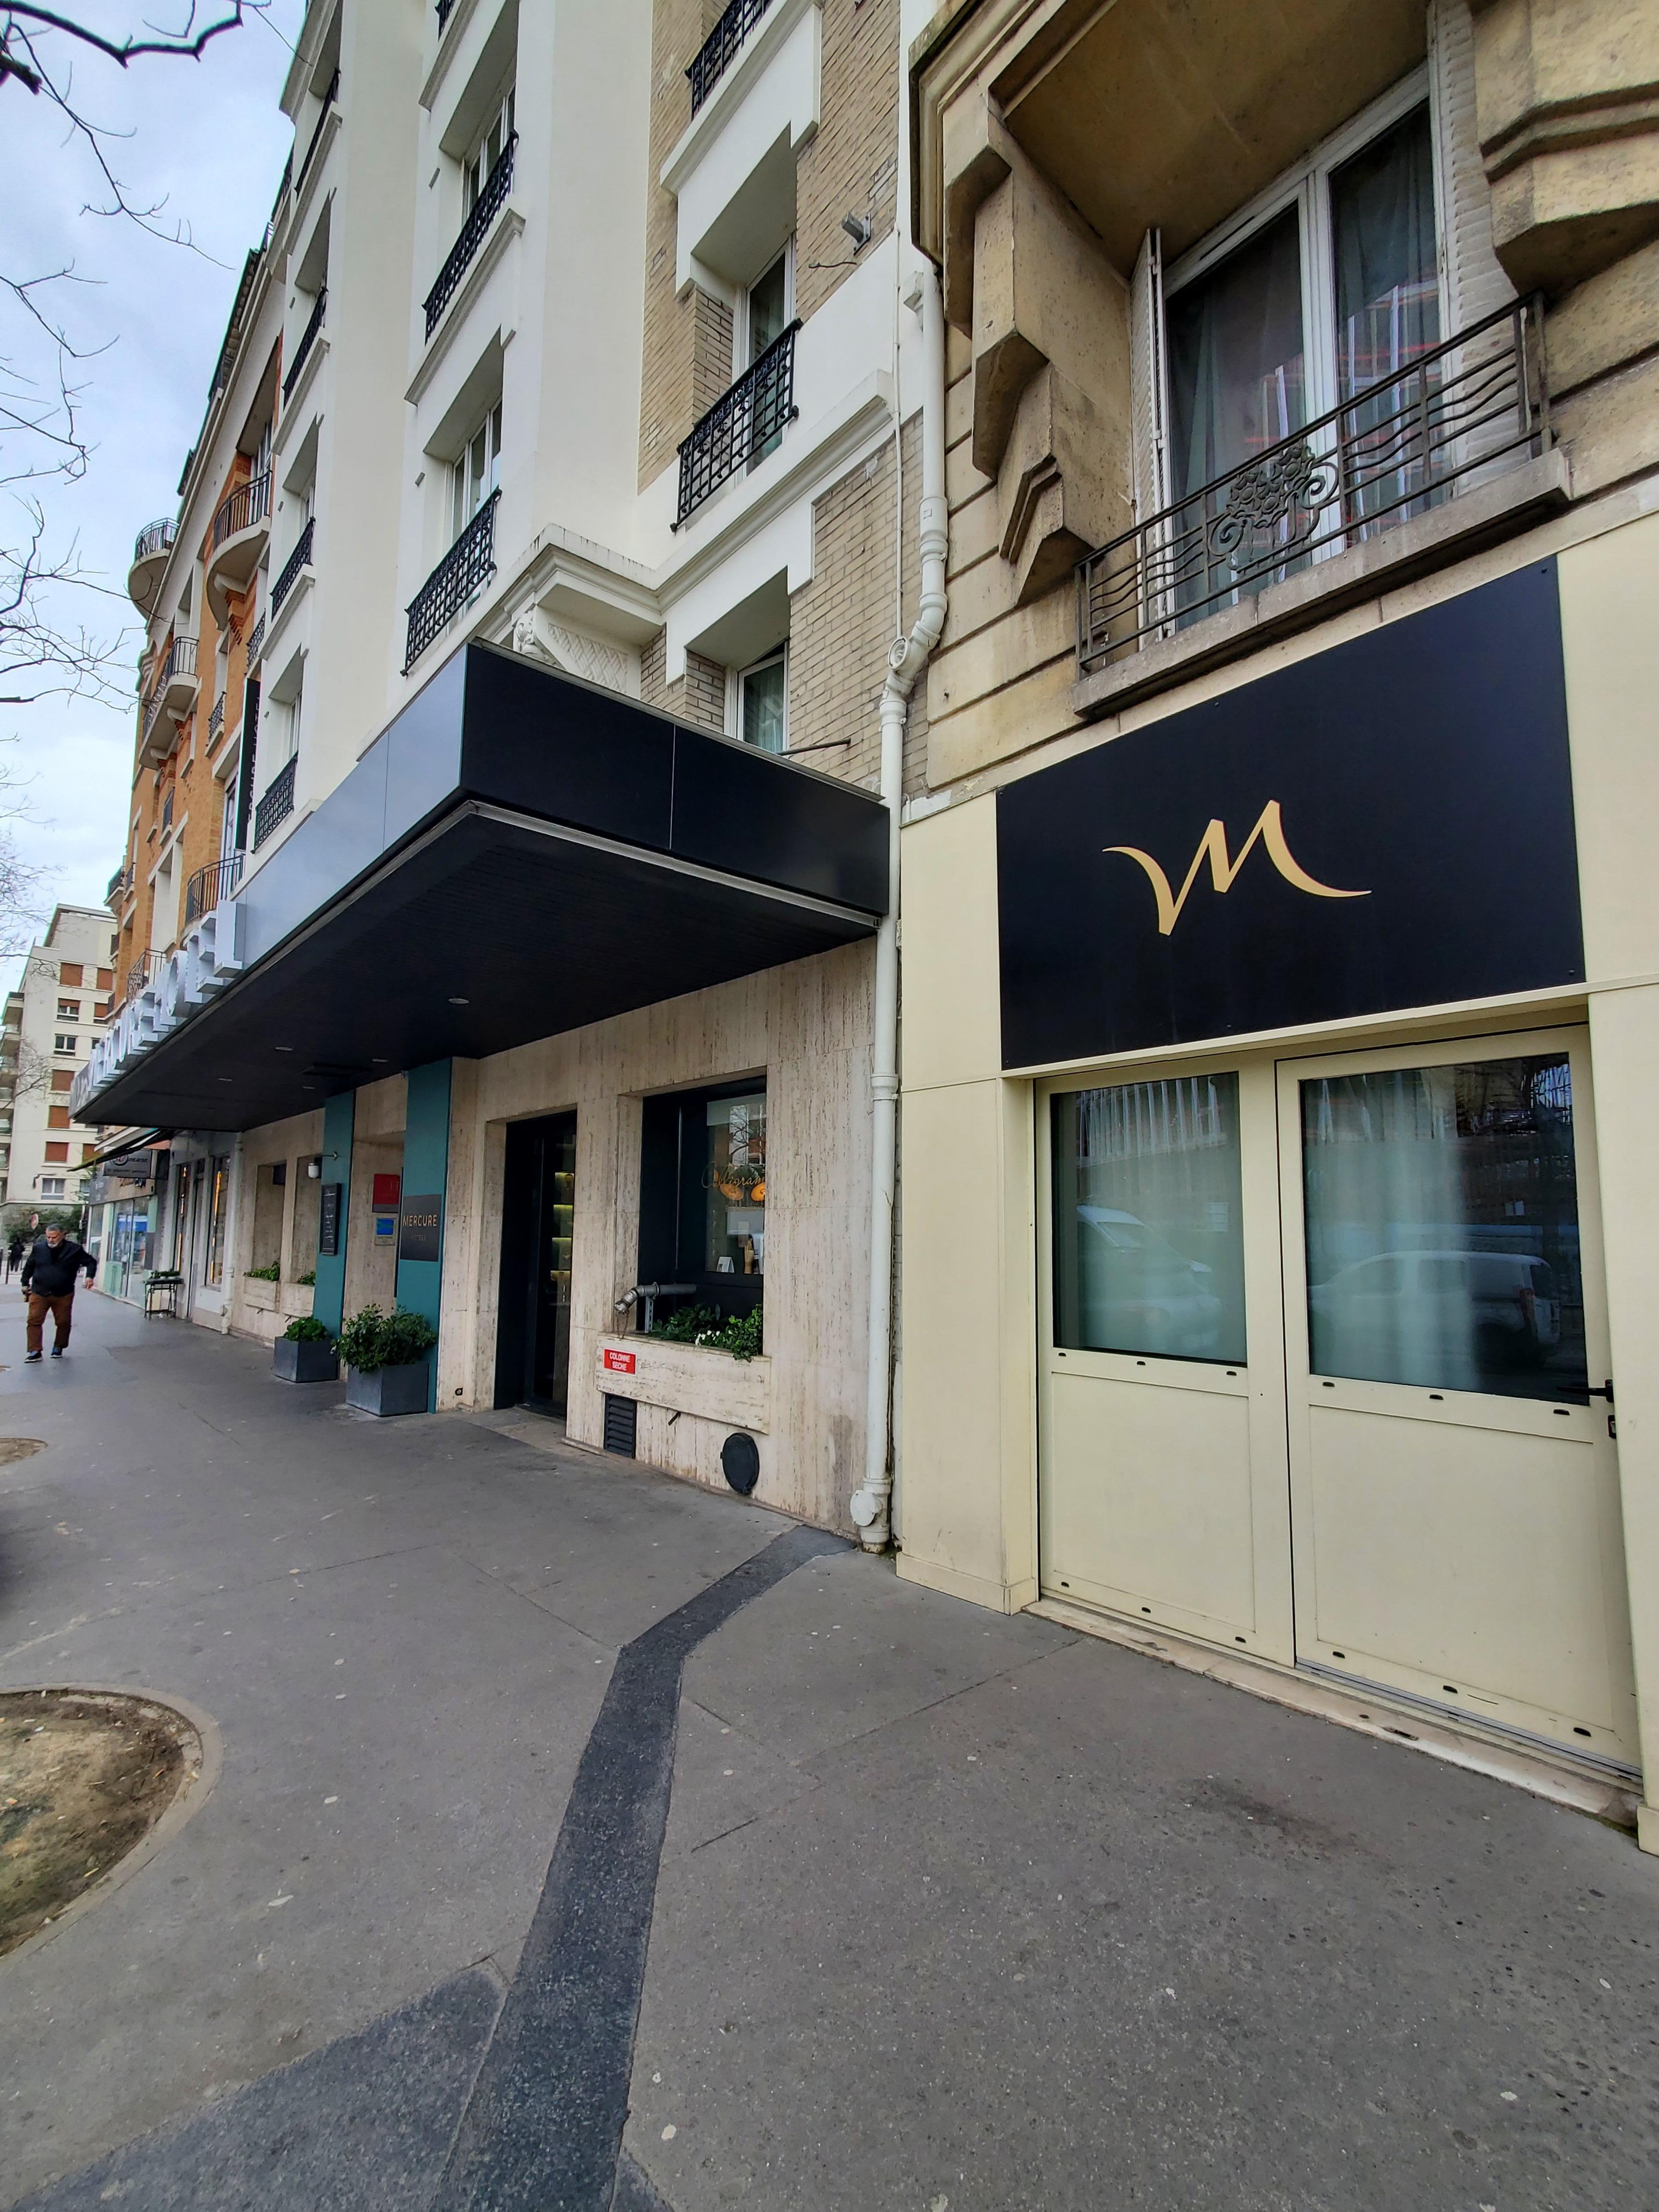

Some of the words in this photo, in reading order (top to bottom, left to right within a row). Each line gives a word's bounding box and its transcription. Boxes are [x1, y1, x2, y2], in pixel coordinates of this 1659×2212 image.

[402, 1214, 438, 1227] MERCURE
[609, 1352, 631, 1363] COLONNE
[612, 1361, 627, 1371] SECHE
